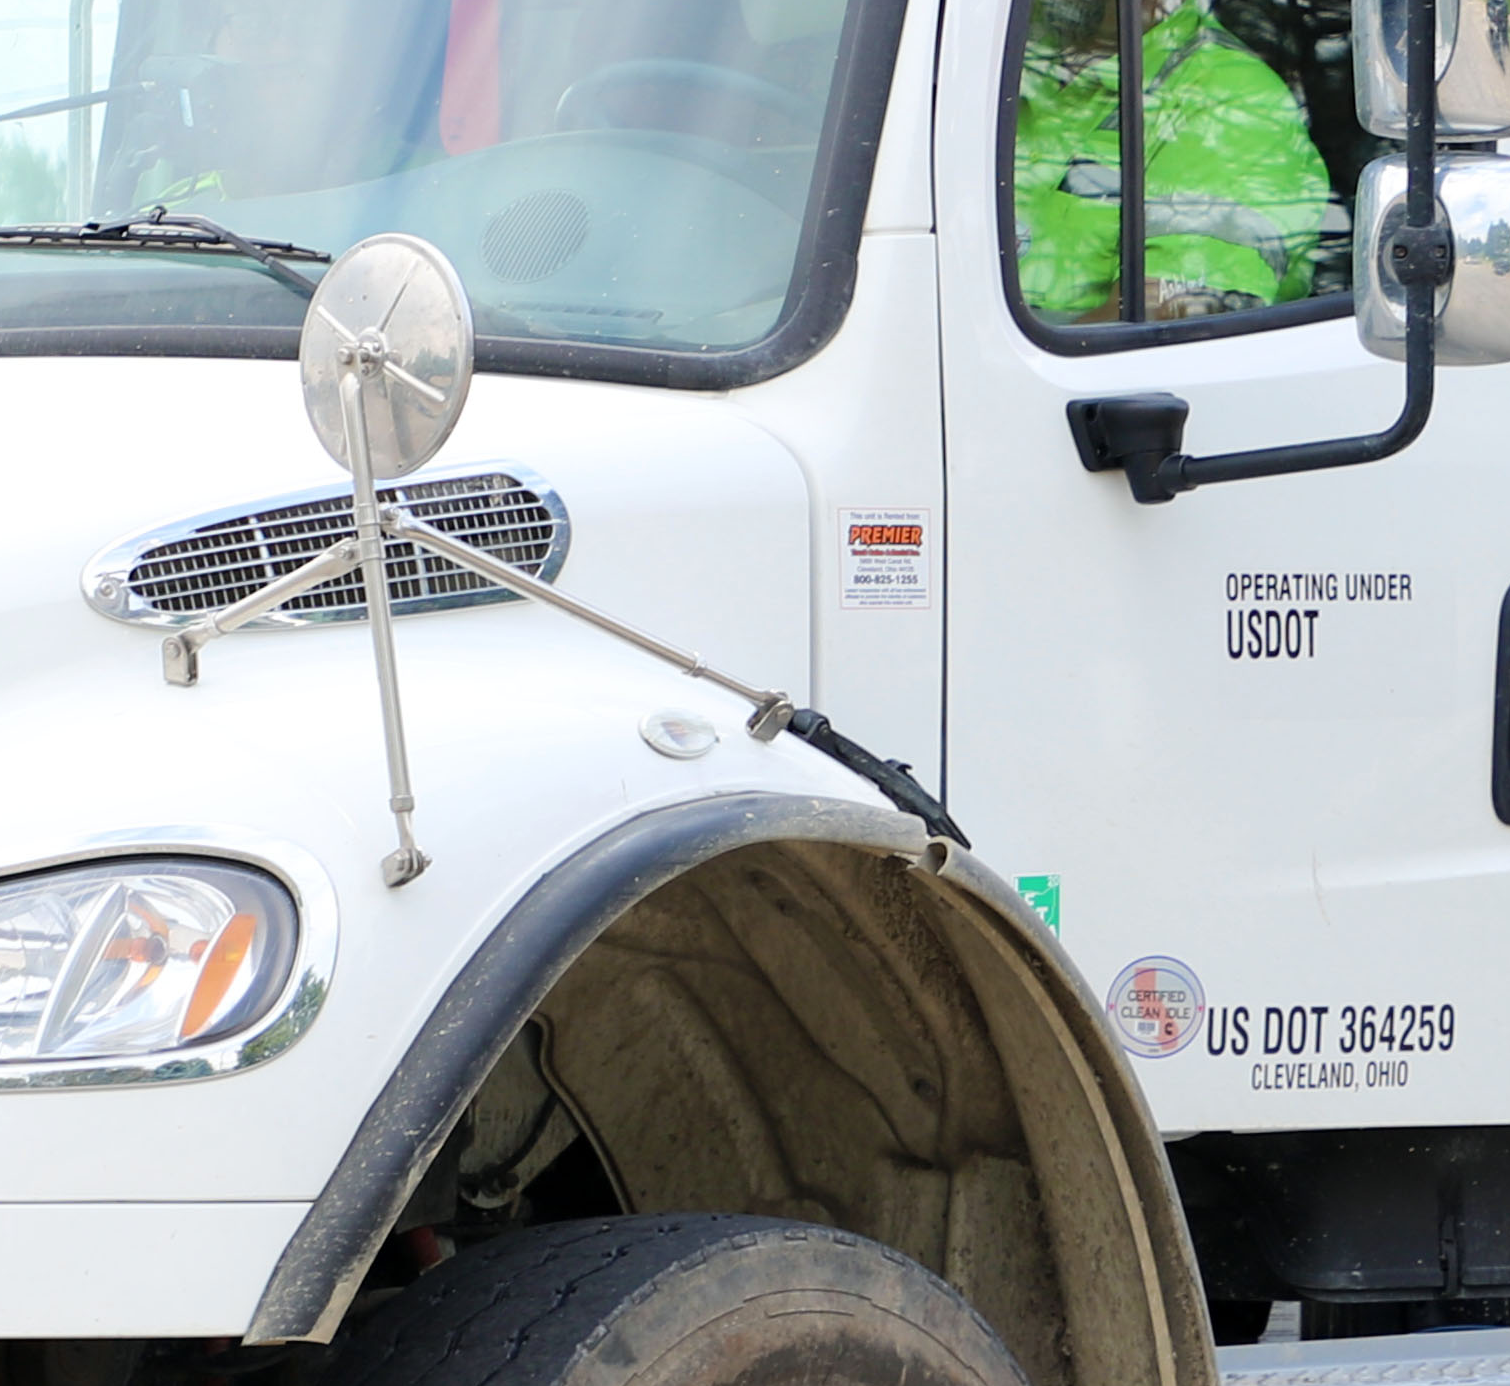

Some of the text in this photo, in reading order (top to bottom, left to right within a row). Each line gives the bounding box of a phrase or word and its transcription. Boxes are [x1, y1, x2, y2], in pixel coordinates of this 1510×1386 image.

[848, 524, 923, 548] PREMIER
[853, 575, 919, 585] 800-825-1255
[1226, 573, 1412, 601] OPERATING UNDER
[1227, 609, 1319, 659] USDOT
[1127, 990, 1186, 1003] CERTIFIED
[1121, 1006, 1191, 1019] CLEAN IDLE
[1207, 1004, 1455, 1056] US DOT 364259
[1251, 1061, 1409, 1092] CLEVELAND, OHIO
